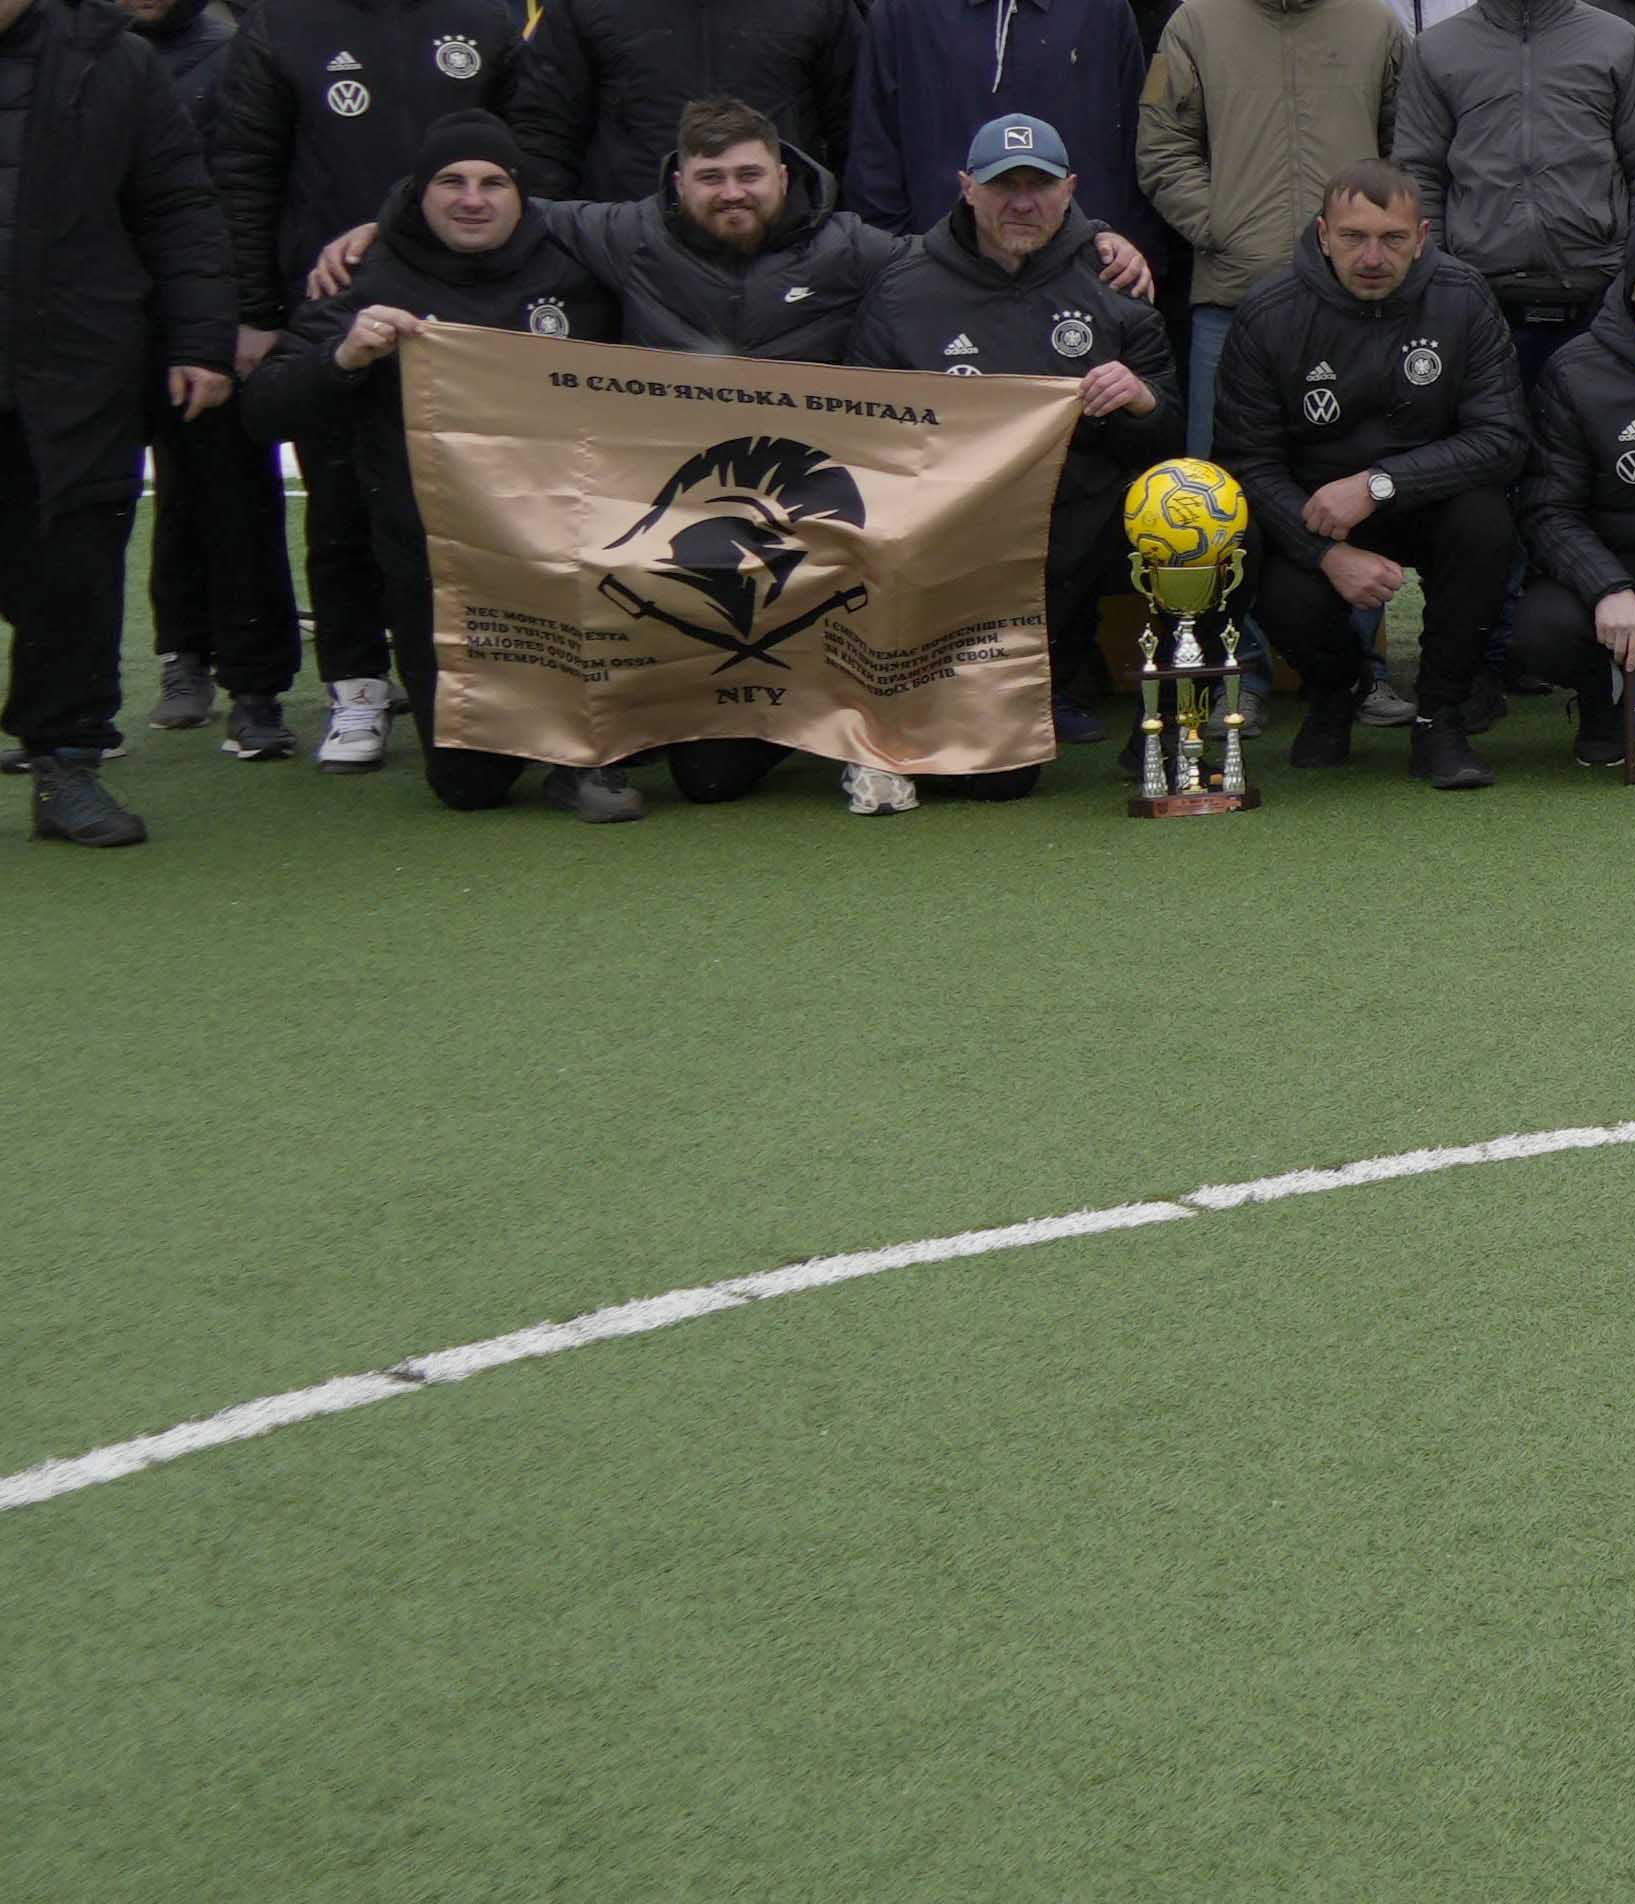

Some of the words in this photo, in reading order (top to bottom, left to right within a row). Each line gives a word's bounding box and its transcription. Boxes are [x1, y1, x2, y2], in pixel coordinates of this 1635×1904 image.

[548, 372, 579, 389] 18
[805, 394, 941, 426] БРИГАДА
[466, 606, 499, 619] NEC
